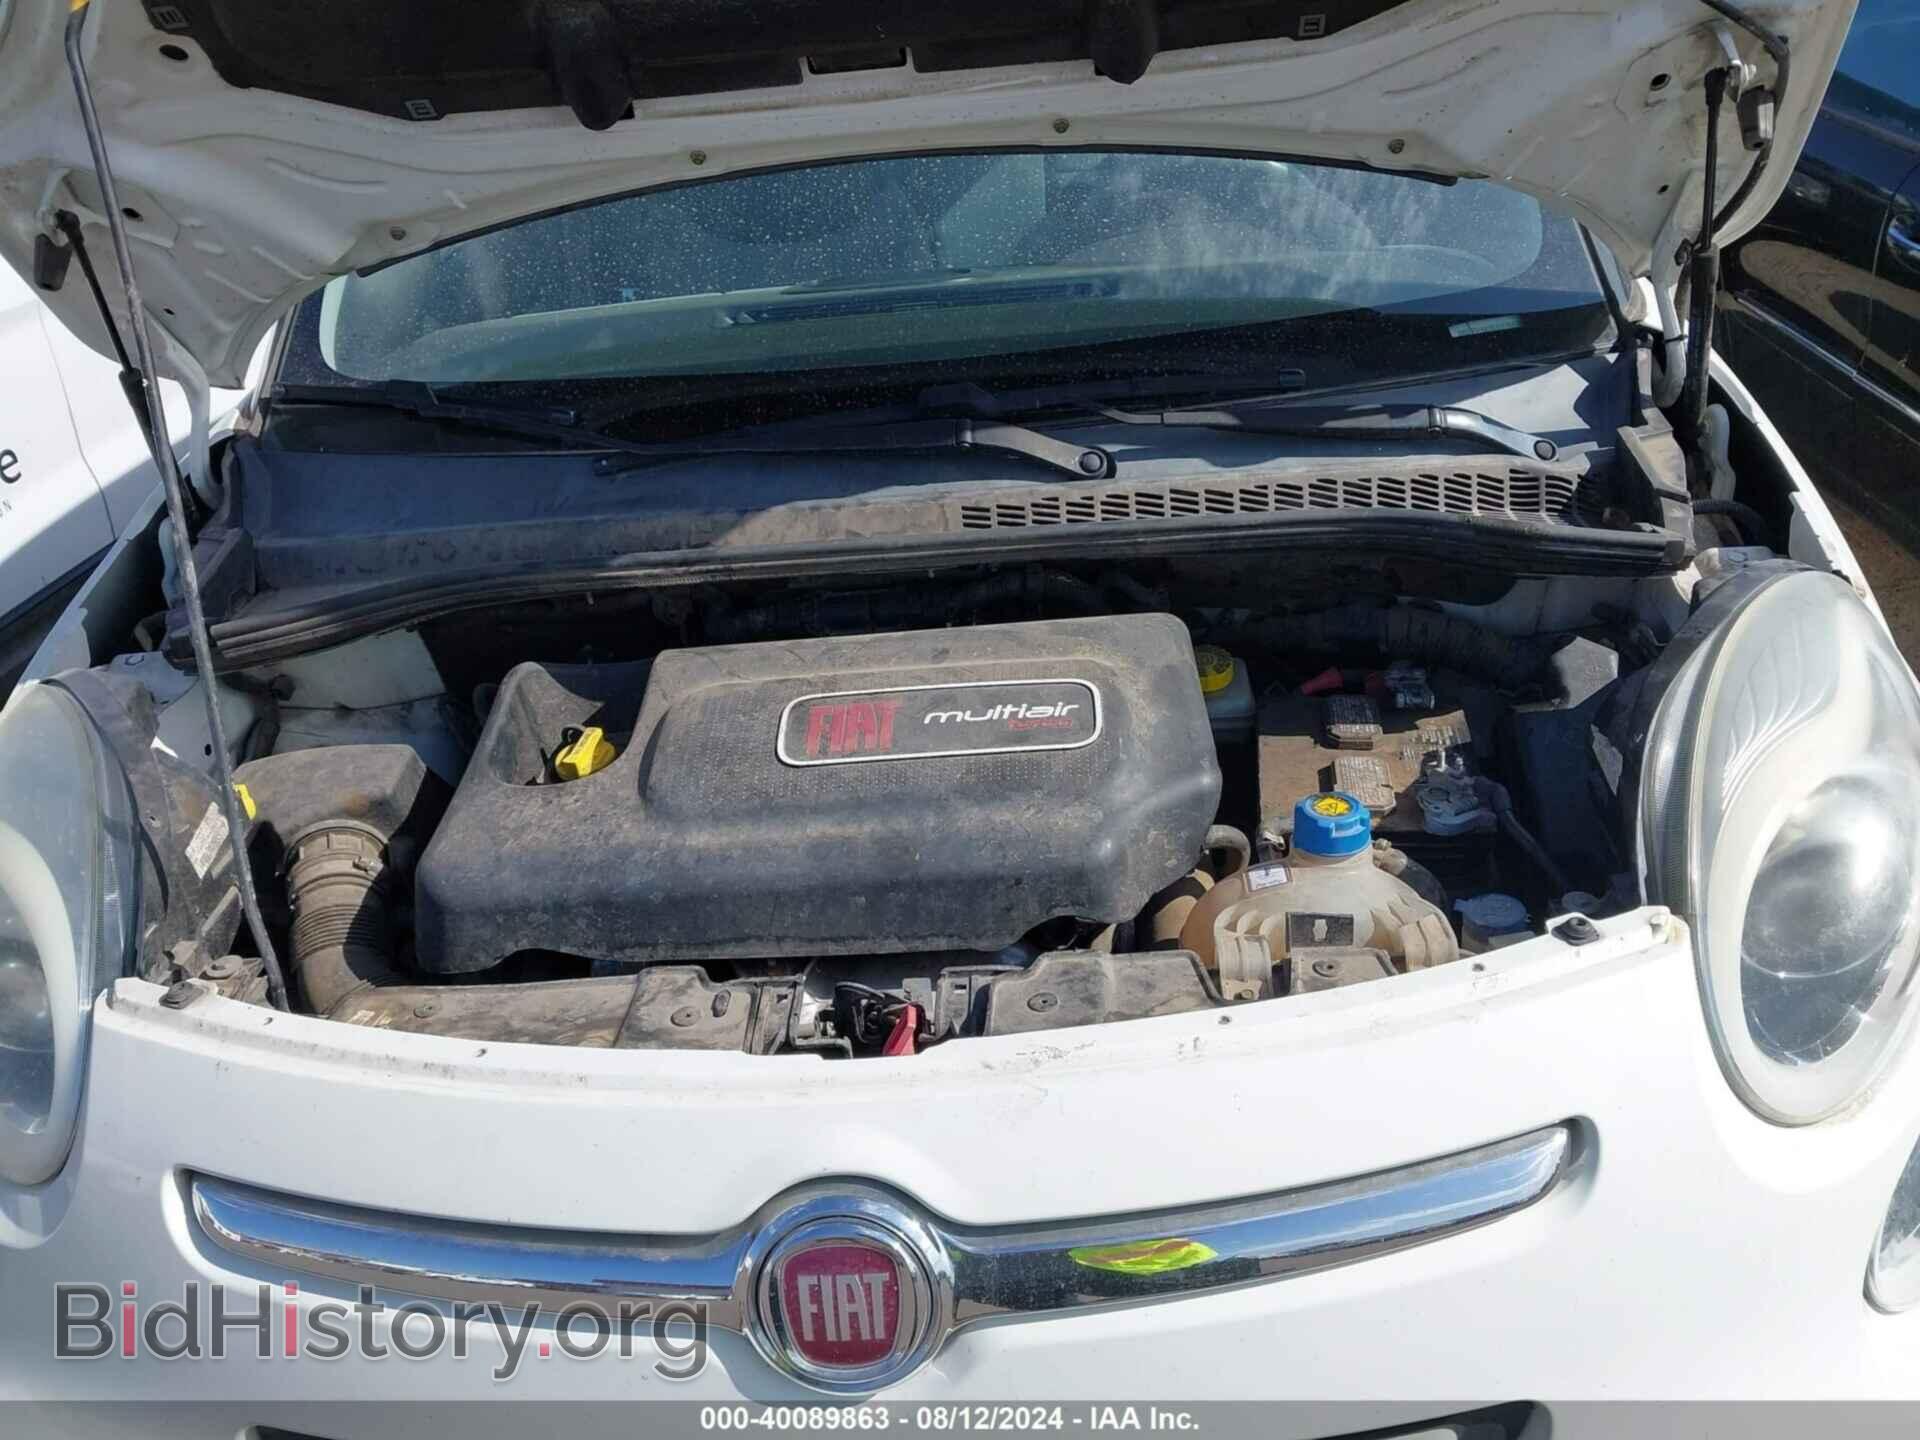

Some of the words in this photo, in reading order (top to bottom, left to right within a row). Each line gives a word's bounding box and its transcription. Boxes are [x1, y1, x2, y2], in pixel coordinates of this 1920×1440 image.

[805, 698, 903, 758] FIAT
[923, 701, 1080, 725] multiair
[797, 1273, 890, 1341] FIAT
